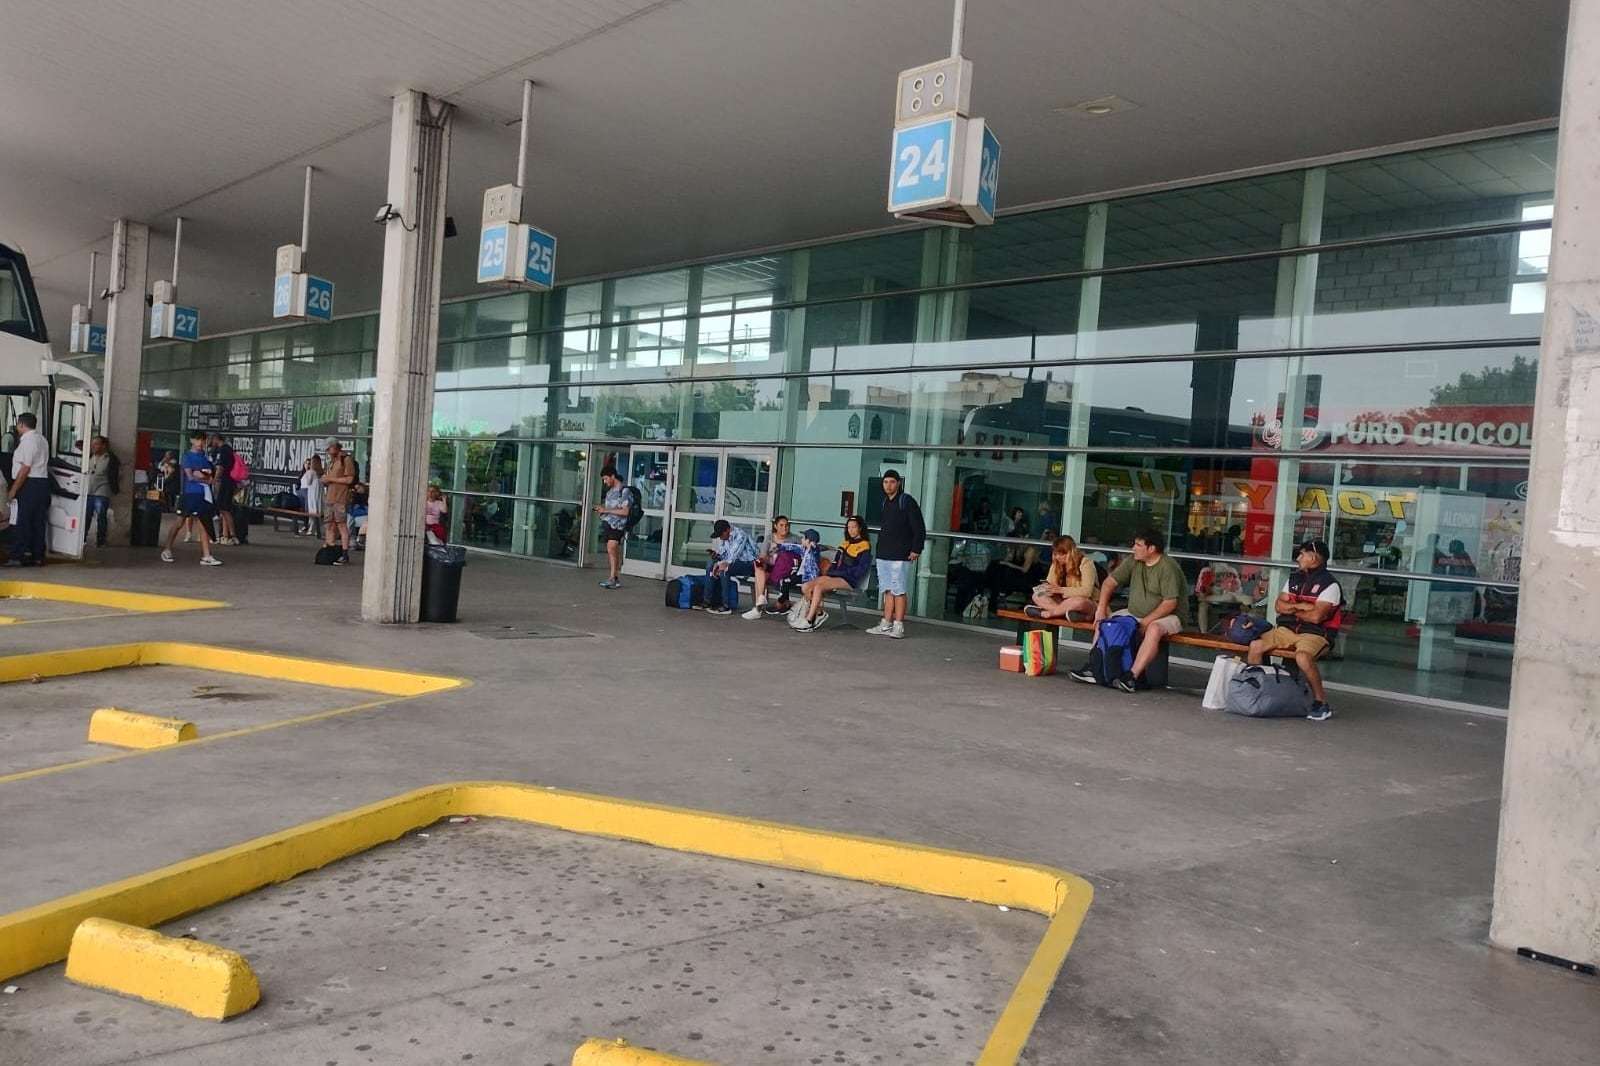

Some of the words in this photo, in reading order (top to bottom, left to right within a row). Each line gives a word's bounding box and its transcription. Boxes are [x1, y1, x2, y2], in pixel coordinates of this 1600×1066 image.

[899, 139, 945, 187] 24
[981, 148, 998, 199] 24
[482, 238, 504, 267] 25
[527, 241, 553, 275] 25
[308, 286, 331, 311] 26
[175, 313, 197, 333] 27
[1330, 421, 1404, 445] PURO
